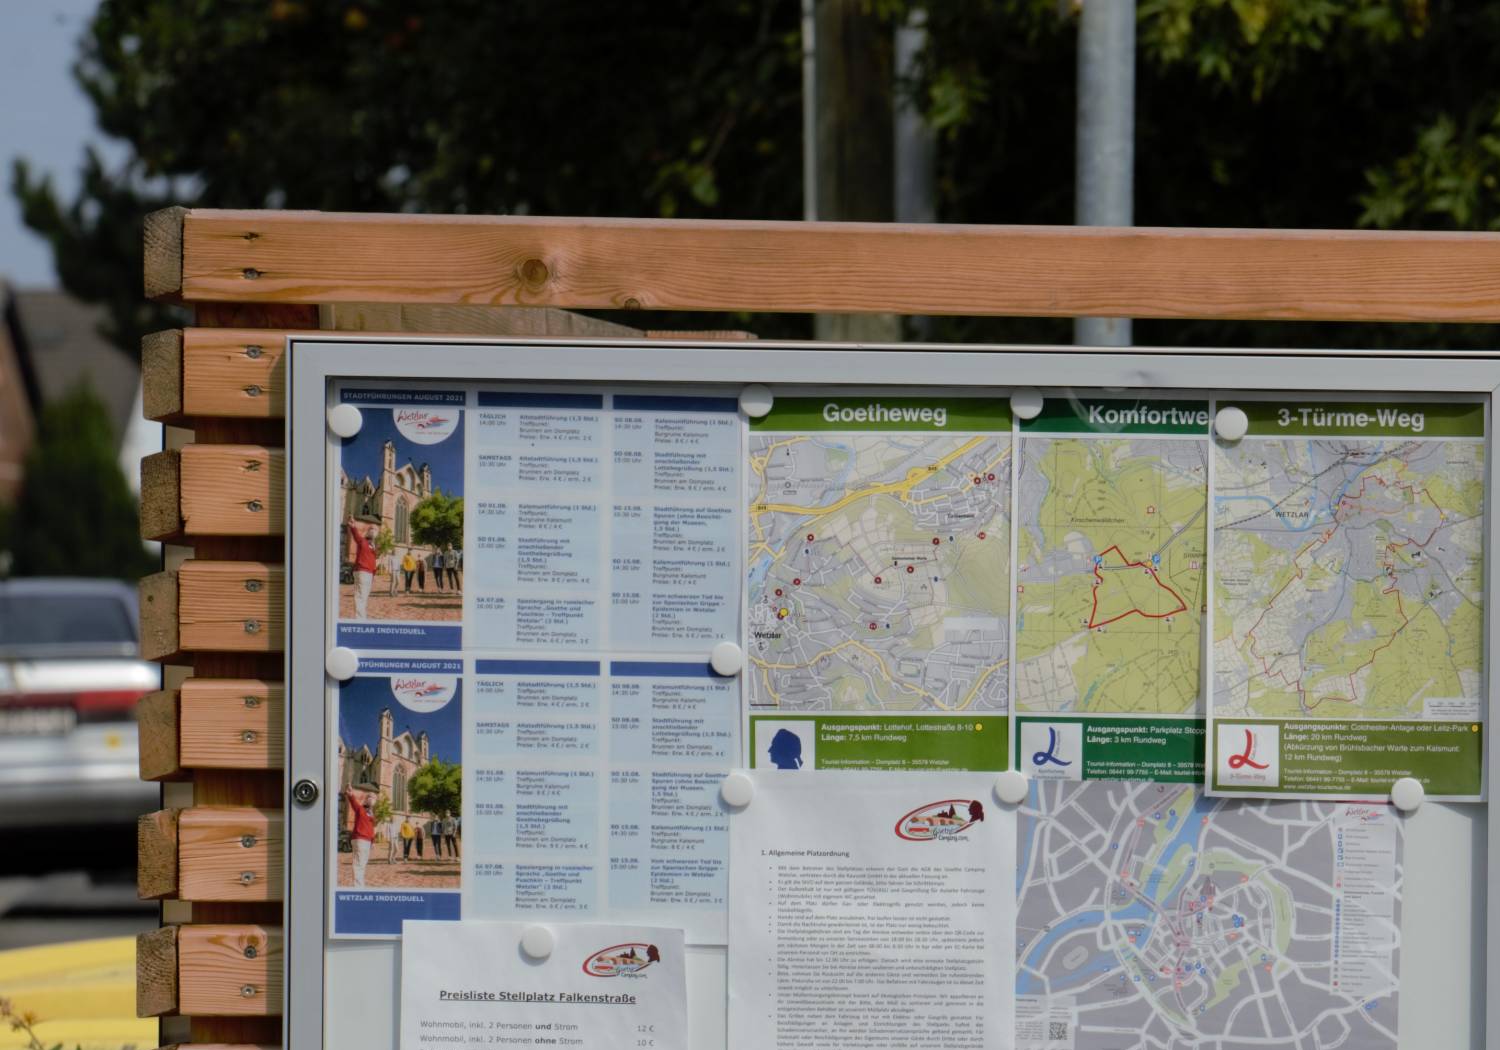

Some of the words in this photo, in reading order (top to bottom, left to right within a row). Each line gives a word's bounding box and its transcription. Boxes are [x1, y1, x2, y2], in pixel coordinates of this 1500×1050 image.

[414, 392, 444, 401] AUGUST
[823, 403, 948, 427] Goetheweg
[1089, 405, 1209, 426] Komfortwe
[1278, 408, 1425, 432] 3-Türme-Weg
[1275, 511, 1309, 519] WETZLAR
[340, 626, 375, 634] WETZLAR
[376, 627, 427, 635] INDIVIDUELL
[754, 631, 782, 640] Wetzlar
[412, 661, 441, 670] AUGUST
[443, 662, 461, 670] 2021
[821, 723, 882, 733] Ausgangspunkt:
[916, 724, 956, 732] Lottestraße
[957, 724, 974, 732] 8-10
[1087, 725, 1149, 734] Ausgangspunkt:
[1150, 726, 1183, 735] Parkplatz
[1284, 722, 1348, 732] Ausgangspunkte:
[1434, 724, 1469, 732] Leitz-Park
[821, 733, 846, 742] Länge:
[862, 733, 872, 741] km
[874, 734, 907, 743] Rundweg
[1087, 736, 1113, 745] Länge:
[1120, 736, 1132, 744] km
[1133, 736, 1167, 745] Rundweg
[1284, 733, 1309, 742] Länge:
[1334, 733, 1367, 742] Rundweg
[1307, 754, 1342, 762] Rundweg)
[768, 849, 805, 857] Allgemeine
[806, 849, 850, 858] Platzordnung
[339, 894, 374, 902] WETZLAR
[440, 989, 495, 1001] Preisliste
[499, 991, 555, 1002] Stellplatz
[559, 993, 637, 1004] Falkenstraße
[420, 1020, 467, 1029] Wohnmobil,
[469, 1021, 486, 1029] inkl.
[496, 1022, 533, 1030] Personen
[554, 1023, 578, 1031] Strom
[420, 1034, 466, 1044] Wohnmobil,
[469, 1035, 486, 1043] inkl.
[496, 1036, 532, 1044] Personen
[535, 1037, 557, 1045] ohne
[559, 1037, 584, 1045] Strom
[637, 1039, 647, 1047] 10
